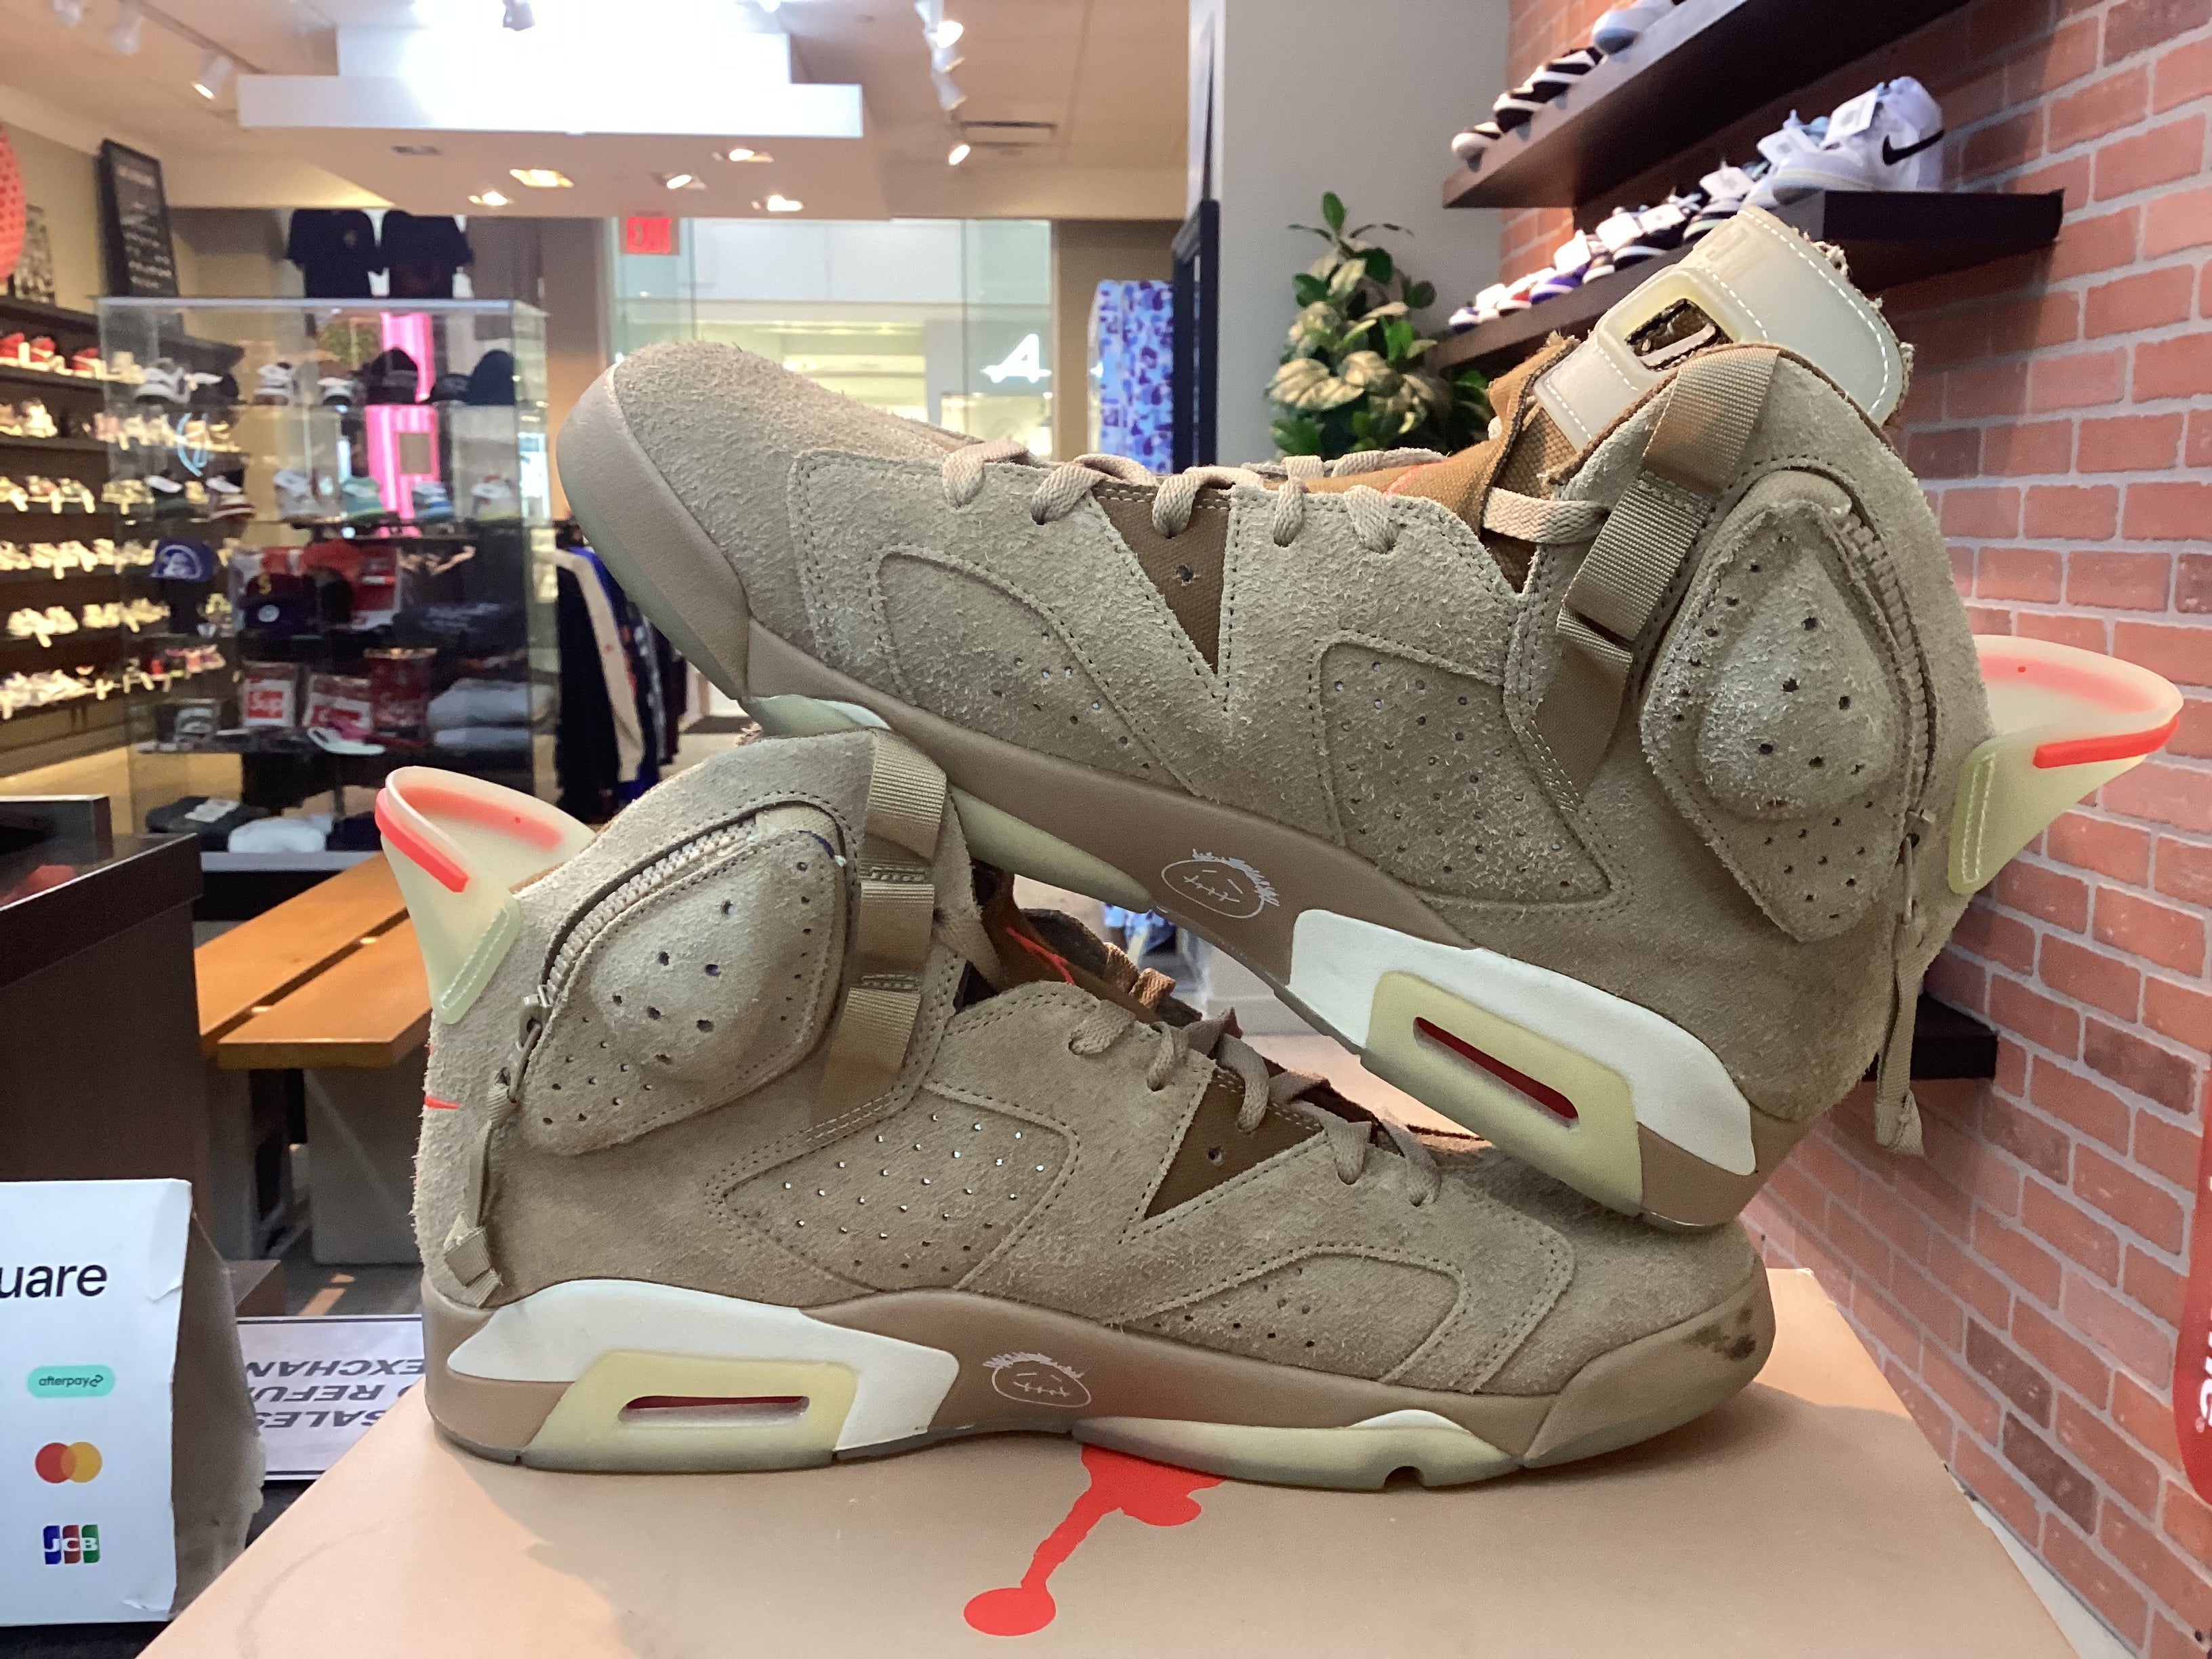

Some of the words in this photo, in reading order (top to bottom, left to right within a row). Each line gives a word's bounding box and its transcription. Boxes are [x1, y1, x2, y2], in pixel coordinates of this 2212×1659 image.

[0, 1265, 108, 1298] uare
[39, 1375, 89, 1388] afterpay
[250, 1385, 386, 1402] REFU
